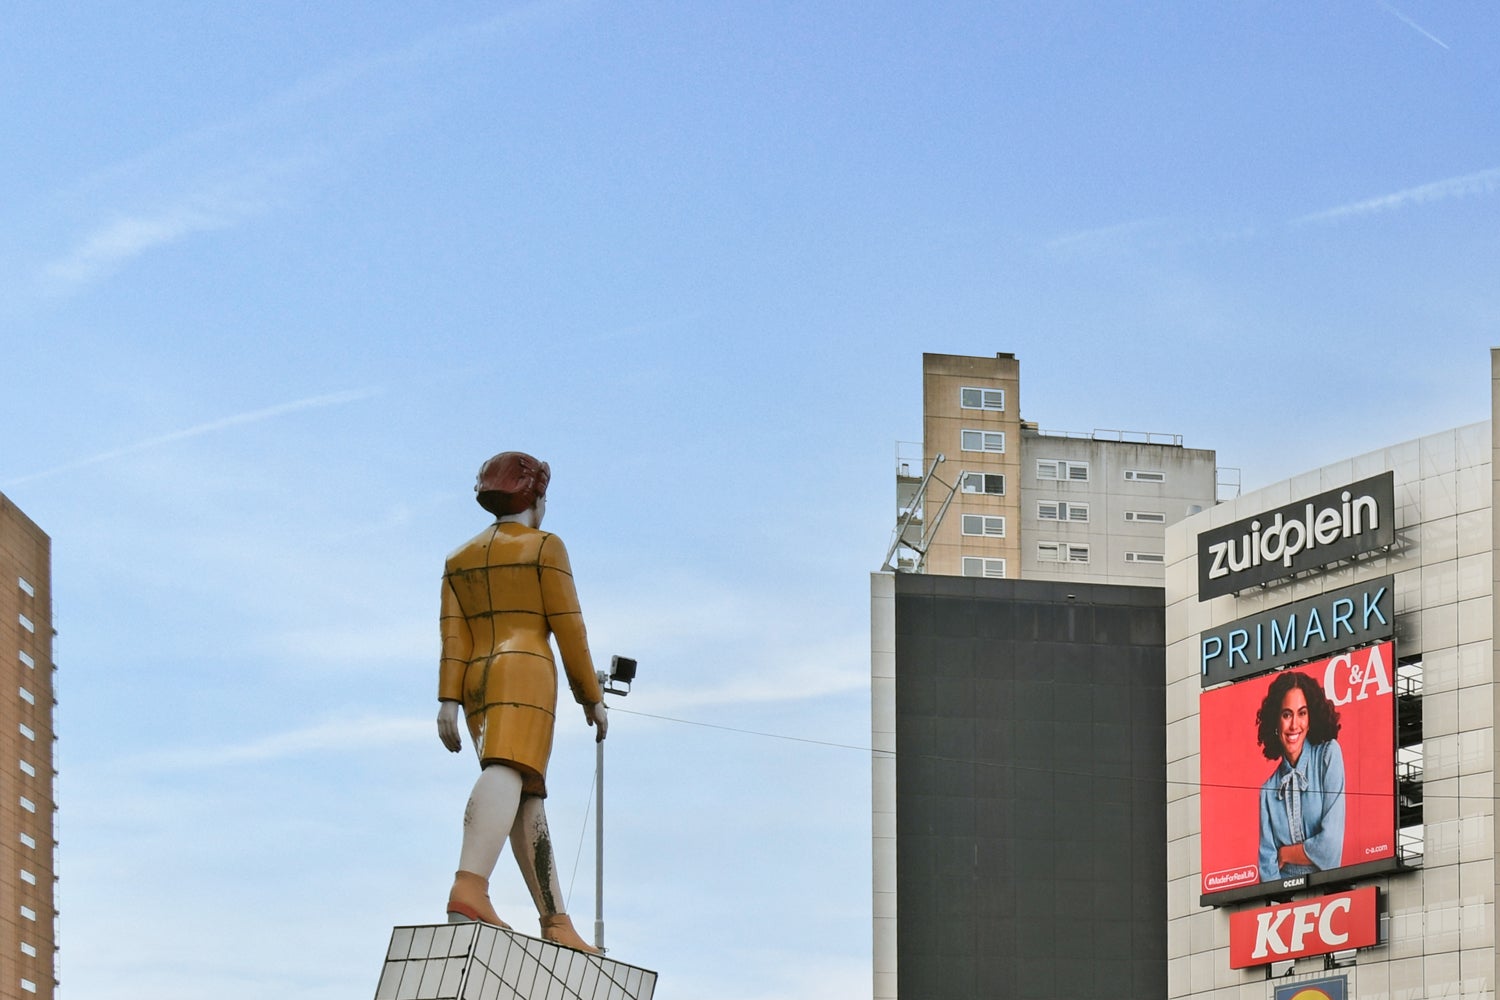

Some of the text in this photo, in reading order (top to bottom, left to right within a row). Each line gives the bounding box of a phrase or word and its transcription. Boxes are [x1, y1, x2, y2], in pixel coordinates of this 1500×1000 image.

[1208, 490, 1379, 580] zuidplein
[1201, 586, 1388, 676] PRIMARK
[1323, 645, 1393, 707] C&A
[1208, 869, 1255, 886] #MadeForRealLife
[1283, 878, 1305, 888] OCEAN
[1251, 897, 1351, 959] KFC
